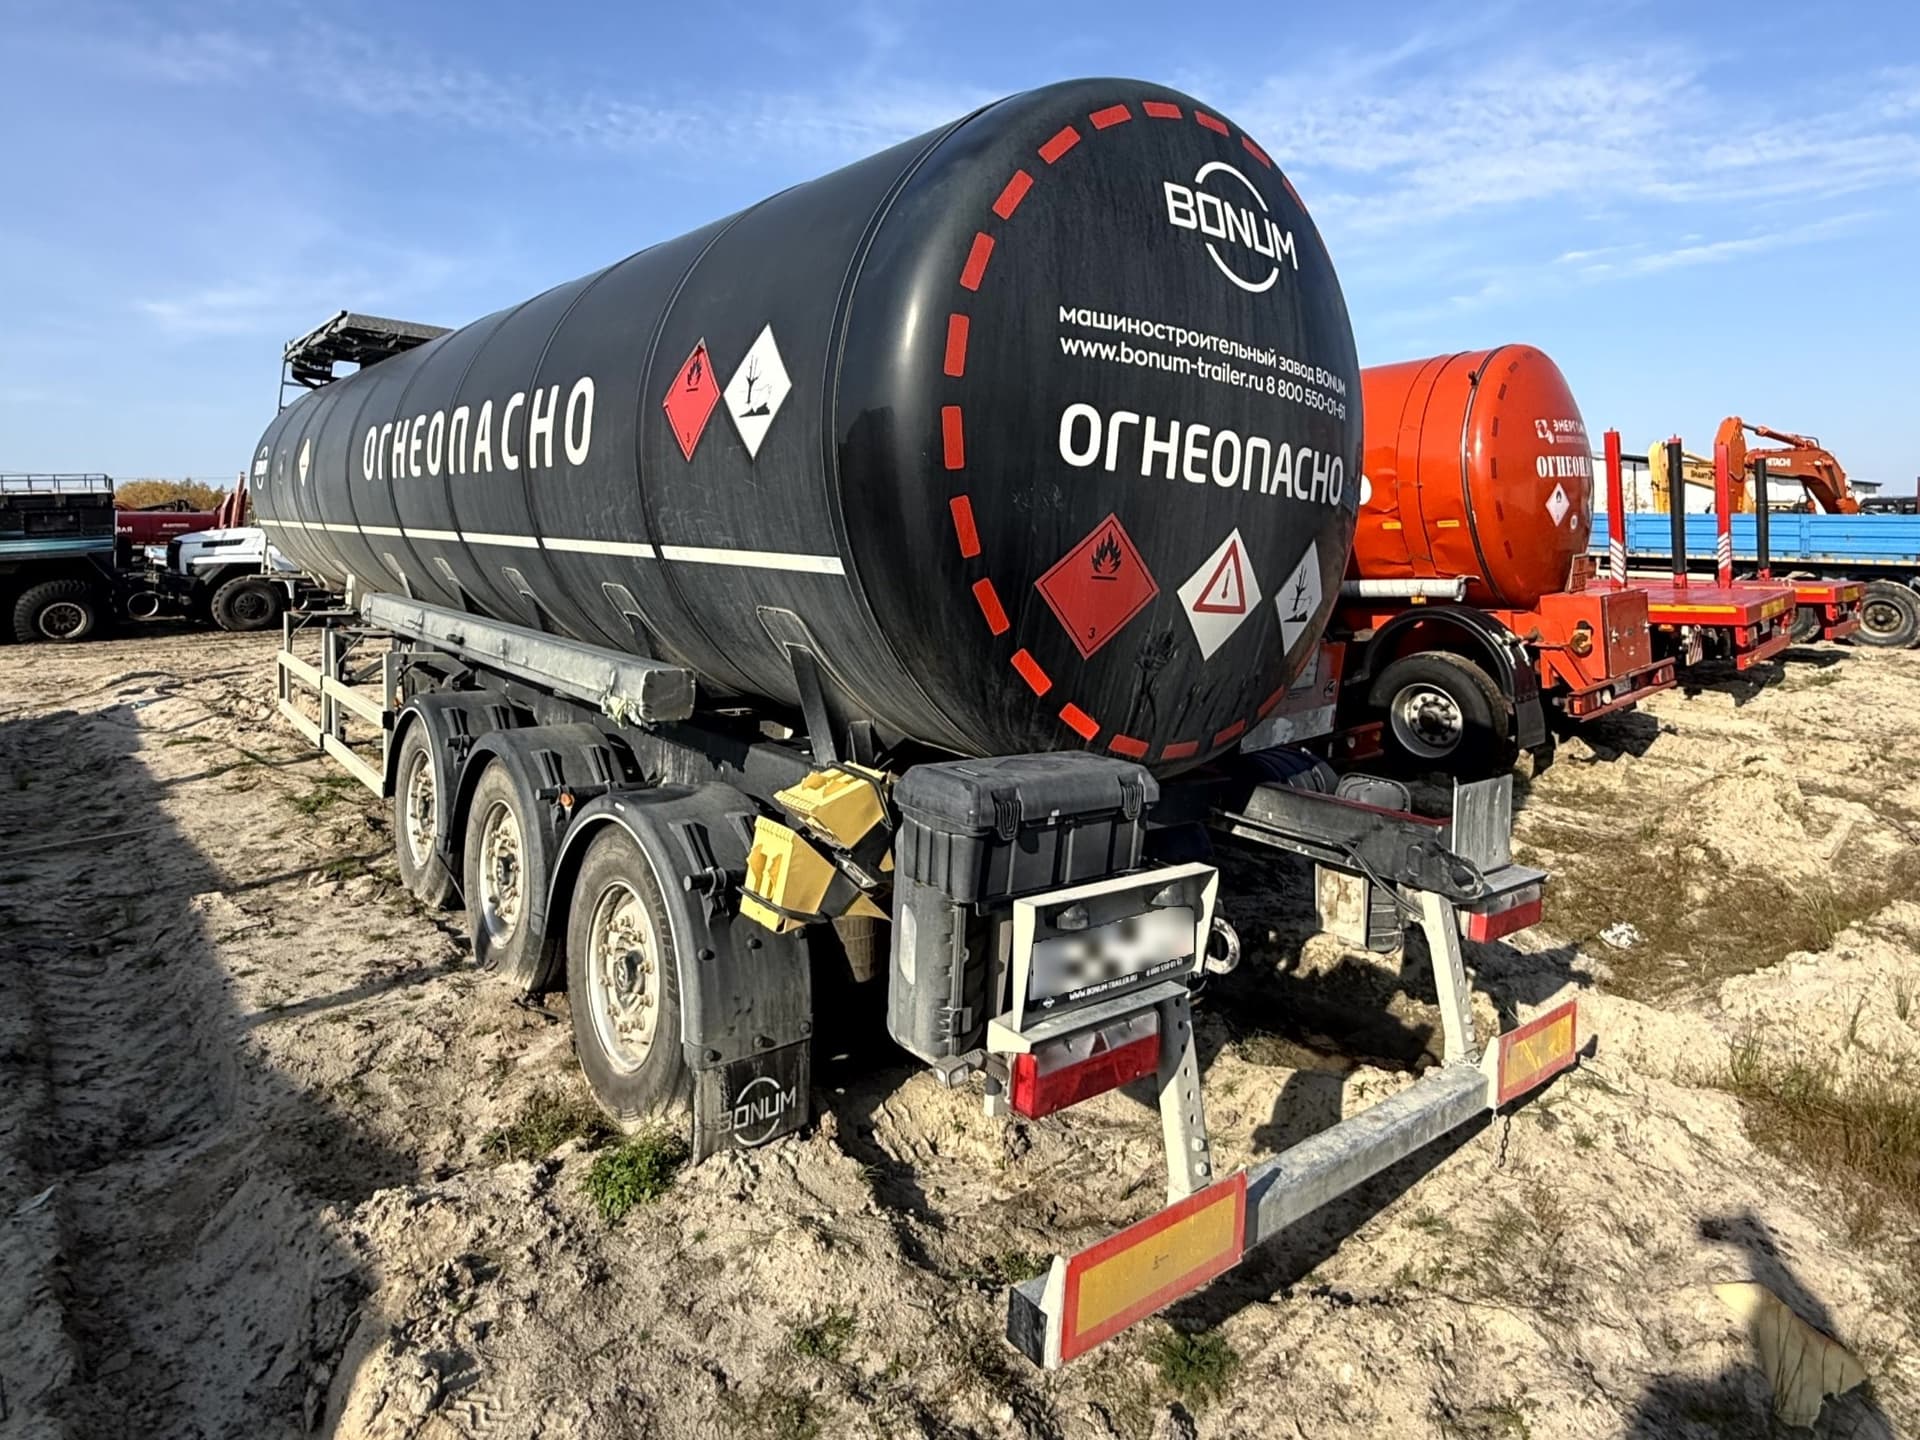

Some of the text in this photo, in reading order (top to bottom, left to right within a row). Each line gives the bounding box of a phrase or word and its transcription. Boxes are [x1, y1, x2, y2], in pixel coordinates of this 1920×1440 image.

[1163, 181, 1299, 271] BONUM
[1059, 305, 1346, 397] машиностроительный завод BONUM
[1059, 336, 1346, 421] www.bonum-trailer.ru 8 800 550-01-61
[363, 376, 595, 481] ОГНЕОПАСНО
[1058, 402, 1344, 506] ОГНЕОПАСНО
[1087, 627, 1096, 640] 3
[717, 1085, 797, 1134] BONUM
